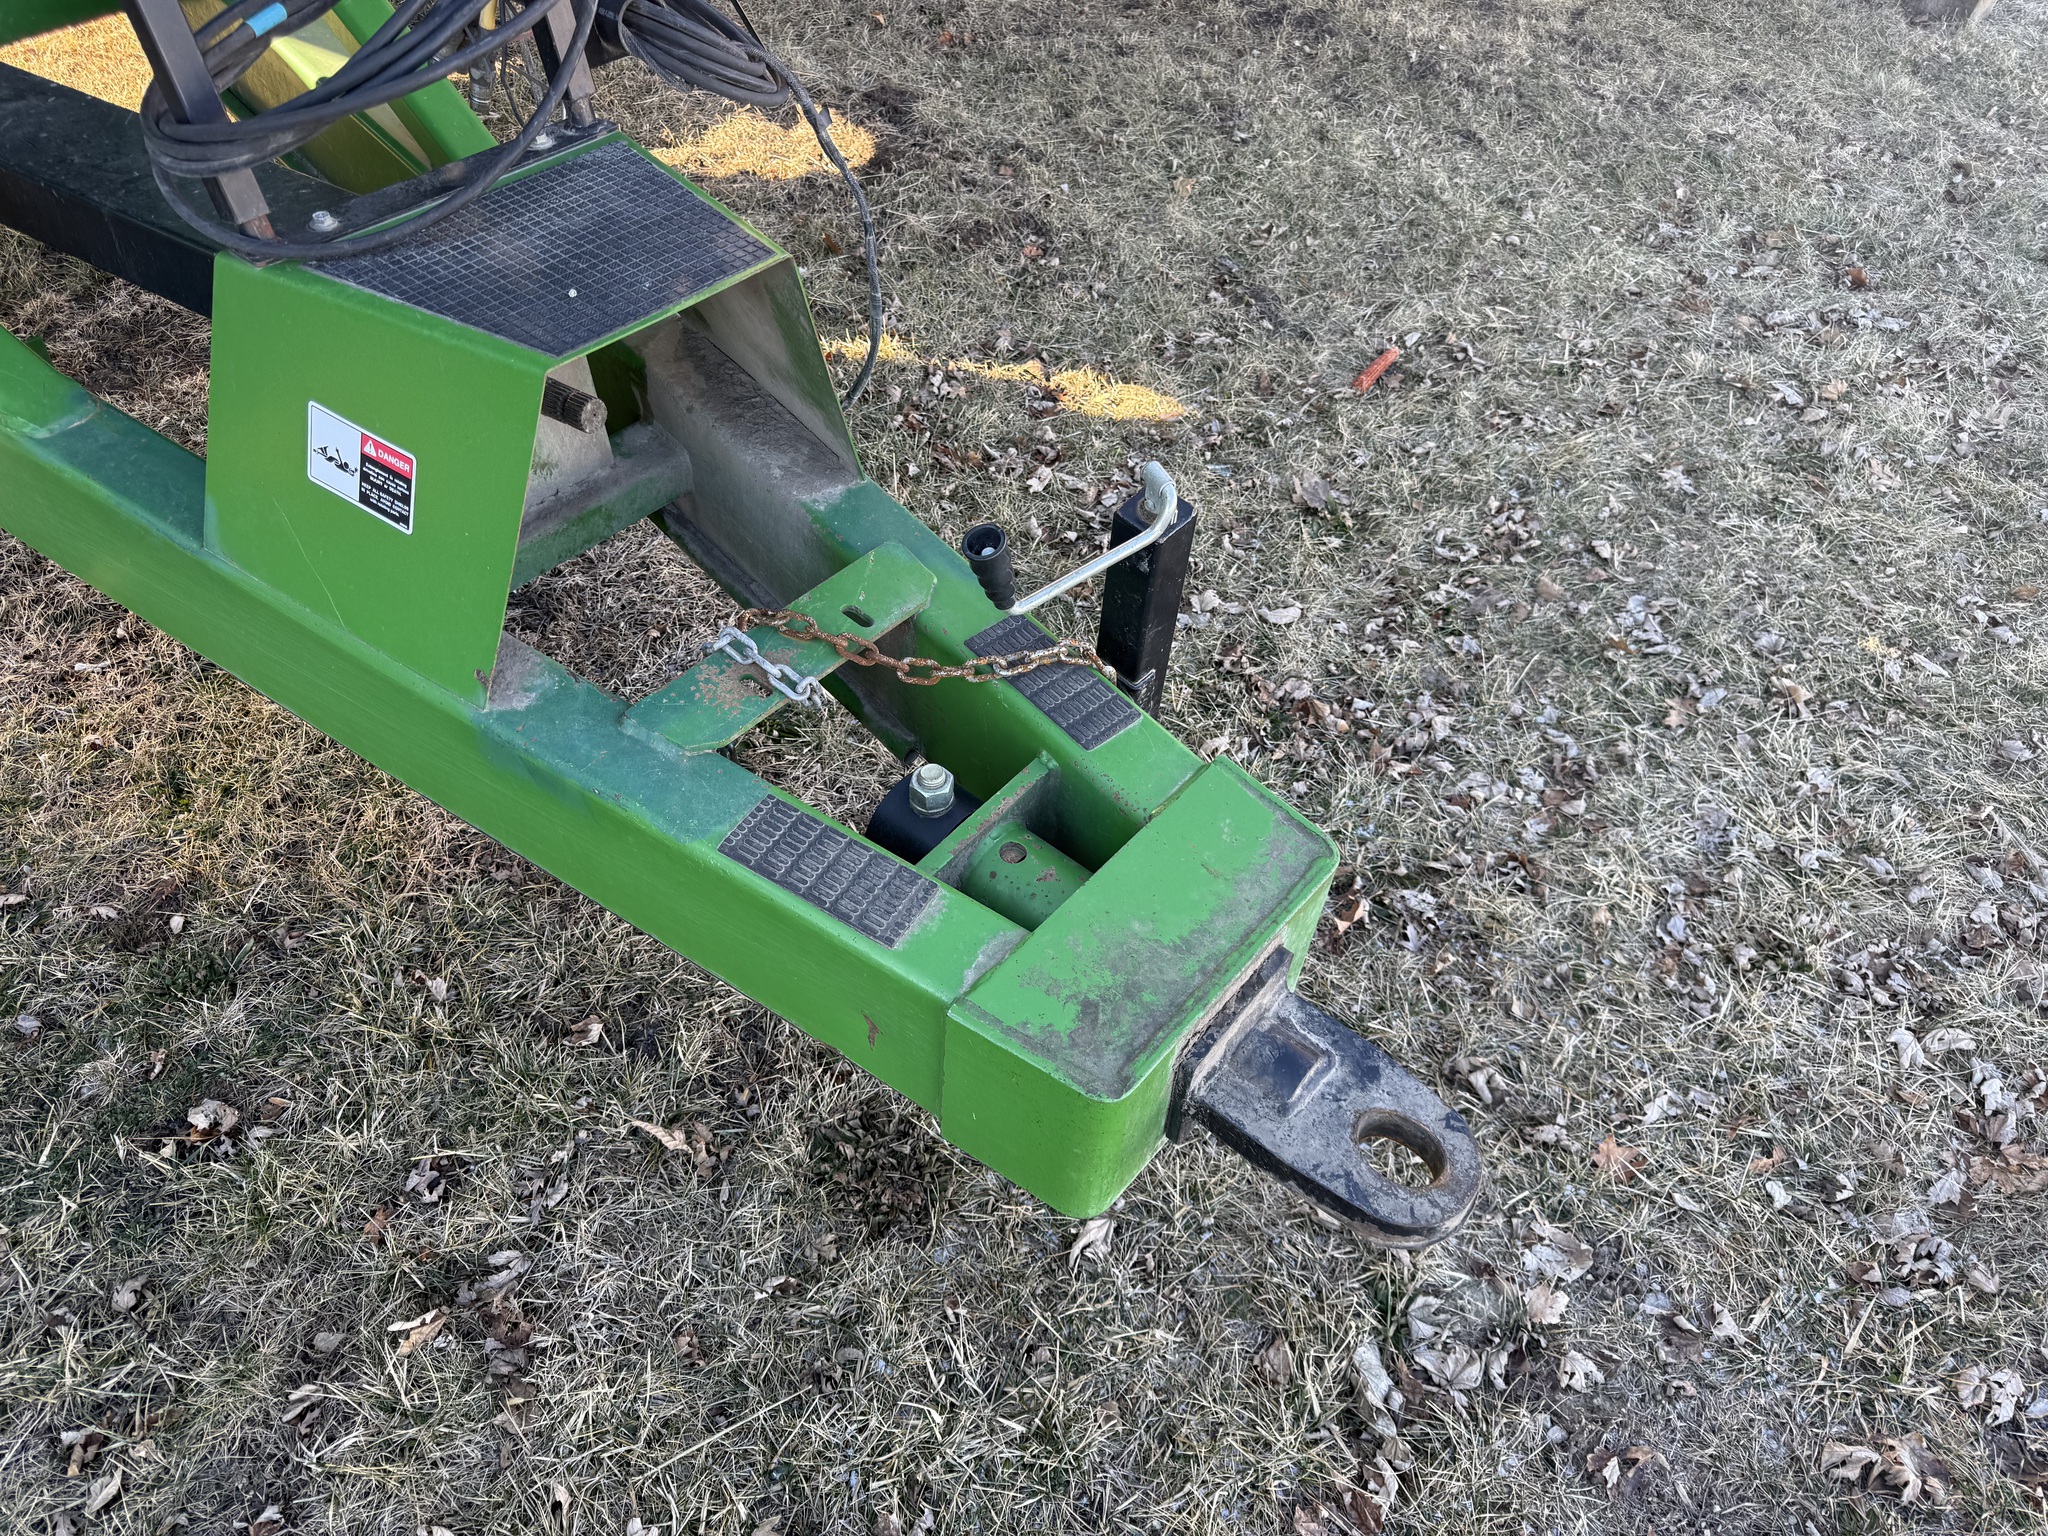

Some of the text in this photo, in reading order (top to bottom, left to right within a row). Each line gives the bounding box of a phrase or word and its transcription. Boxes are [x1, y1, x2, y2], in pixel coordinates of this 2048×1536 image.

[378, 449, 410, 473] DANGER
[380, 491, 393, 504] SAFETY
[392, 503, 409, 517] CONTACT
